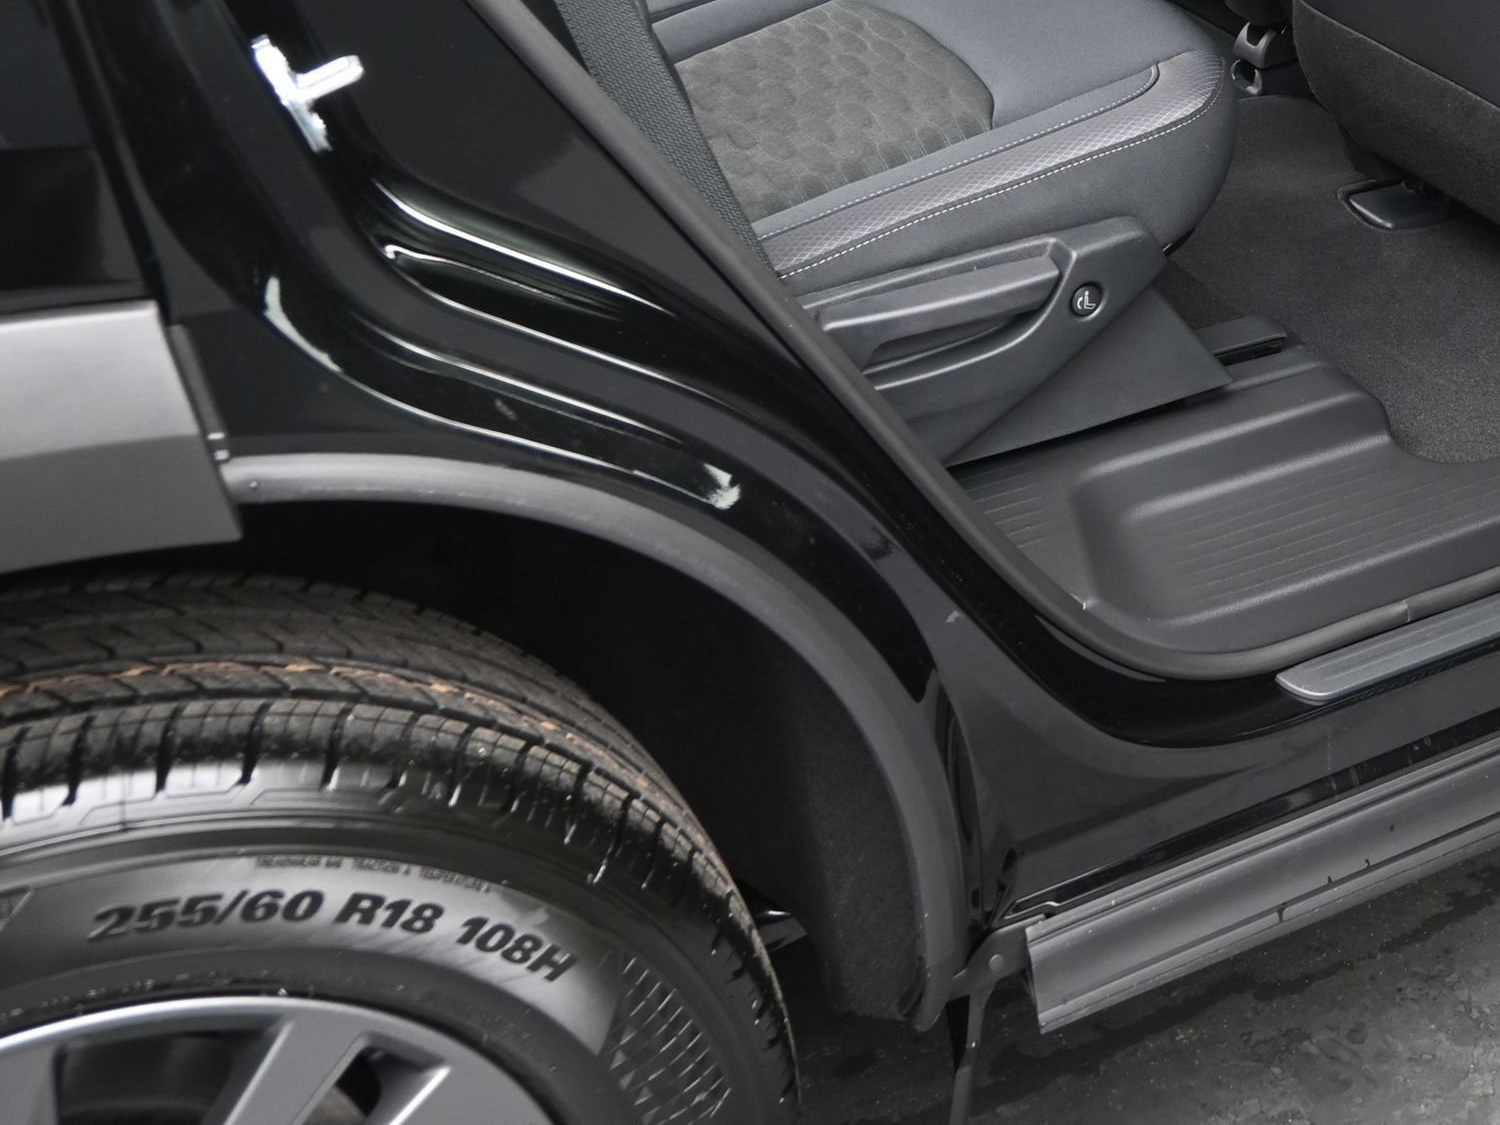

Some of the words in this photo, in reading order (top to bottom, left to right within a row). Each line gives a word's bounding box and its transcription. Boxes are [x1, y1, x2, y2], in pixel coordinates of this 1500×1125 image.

[87, 889, 325, 942] 255/60
[333, 891, 445, 934] R18
[455, 916, 577, 982] 108H
